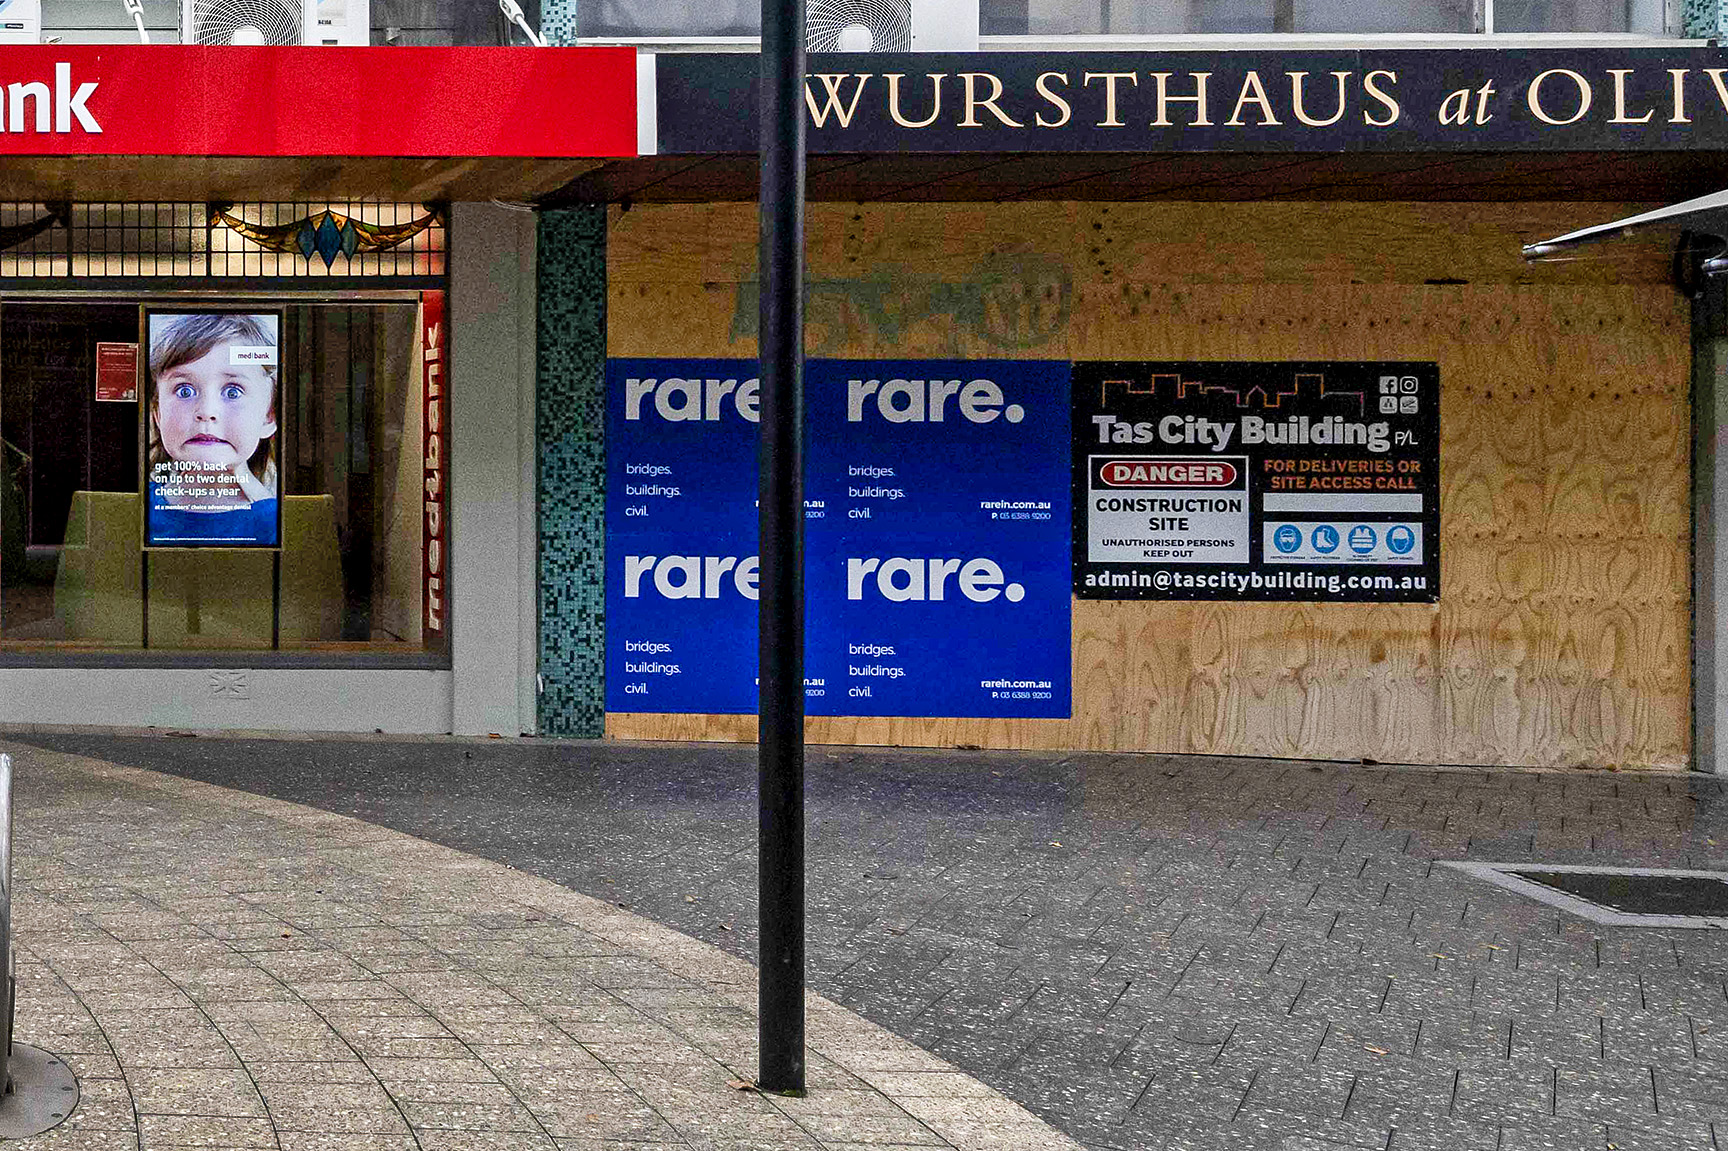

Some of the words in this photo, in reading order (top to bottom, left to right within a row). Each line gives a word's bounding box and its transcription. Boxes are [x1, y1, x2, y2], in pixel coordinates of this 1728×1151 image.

[805, 70, 1400, 128] WURSTHAUS
[1437, 79, 1496, 125] at
[847, 379, 1025, 423] rare.
[1092, 415, 1154, 444] Tas
[1158, 415, 1236, 452] City
[1241, 415, 1391, 453] Building
[1394, 429, 1419, 446] P/L
[154, 462, 172, 472] get
[173, 461, 202, 471] 100%
[203, 461, 227, 471] back
[625, 462, 672, 477] bridges.
[848, 464, 896, 478] bridges.
[1264, 459, 1296, 473] FOR
[1299, 459, 1394, 473] DELIVERIES
[1397, 460, 1422, 473] OR
[154, 475, 167, 484] on
[169, 475, 183, 485] up
[184, 474, 195, 484] to
[196, 474, 217, 484] two
[217, 473, 249, 484] dental
[425, 322, 441, 631] medibank
[1113, 465, 1223, 482] DANGER
[1271, 476, 1306, 489] SITE
[1308, 476, 1372, 489] ACCESS
[1375, 476, 1416, 489] CALL
[154, 486, 207, 498] check-ups
[208, 488, 215, 496] a
[217, 488, 240, 498] year
[625, 484, 682, 498] buildings.
[848, 486, 906, 500] buildings.
[625, 505, 649, 517] civil.
[980, 499, 1051, 509] rarein.com.au
[1095, 498, 1242, 513] CONSTRUCTION
[848, 507, 872, 519] civil.
[1148, 517, 1189, 531] SITE
[1102, 539, 1185, 548] UNAUTHORISED
[1186, 539, 1235, 548] PERSONS
[1143, 550, 1170, 558] KEEP
[1172, 550, 1194, 558] OUT
[847, 557, 1025, 602] rare.
[1085, 569, 1427, 593] admin@tascitybuilding.com.au
[625, 640, 672, 654] bridges.
[848, 643, 896, 657] bridges.
[625, 661, 682, 675] buildings.
[848, 664, 906, 679] buildings.
[624, 683, 649, 694] civil.
[980, 678, 1052, 688] rarein.com.au
[848, 685, 872, 697] civil.
